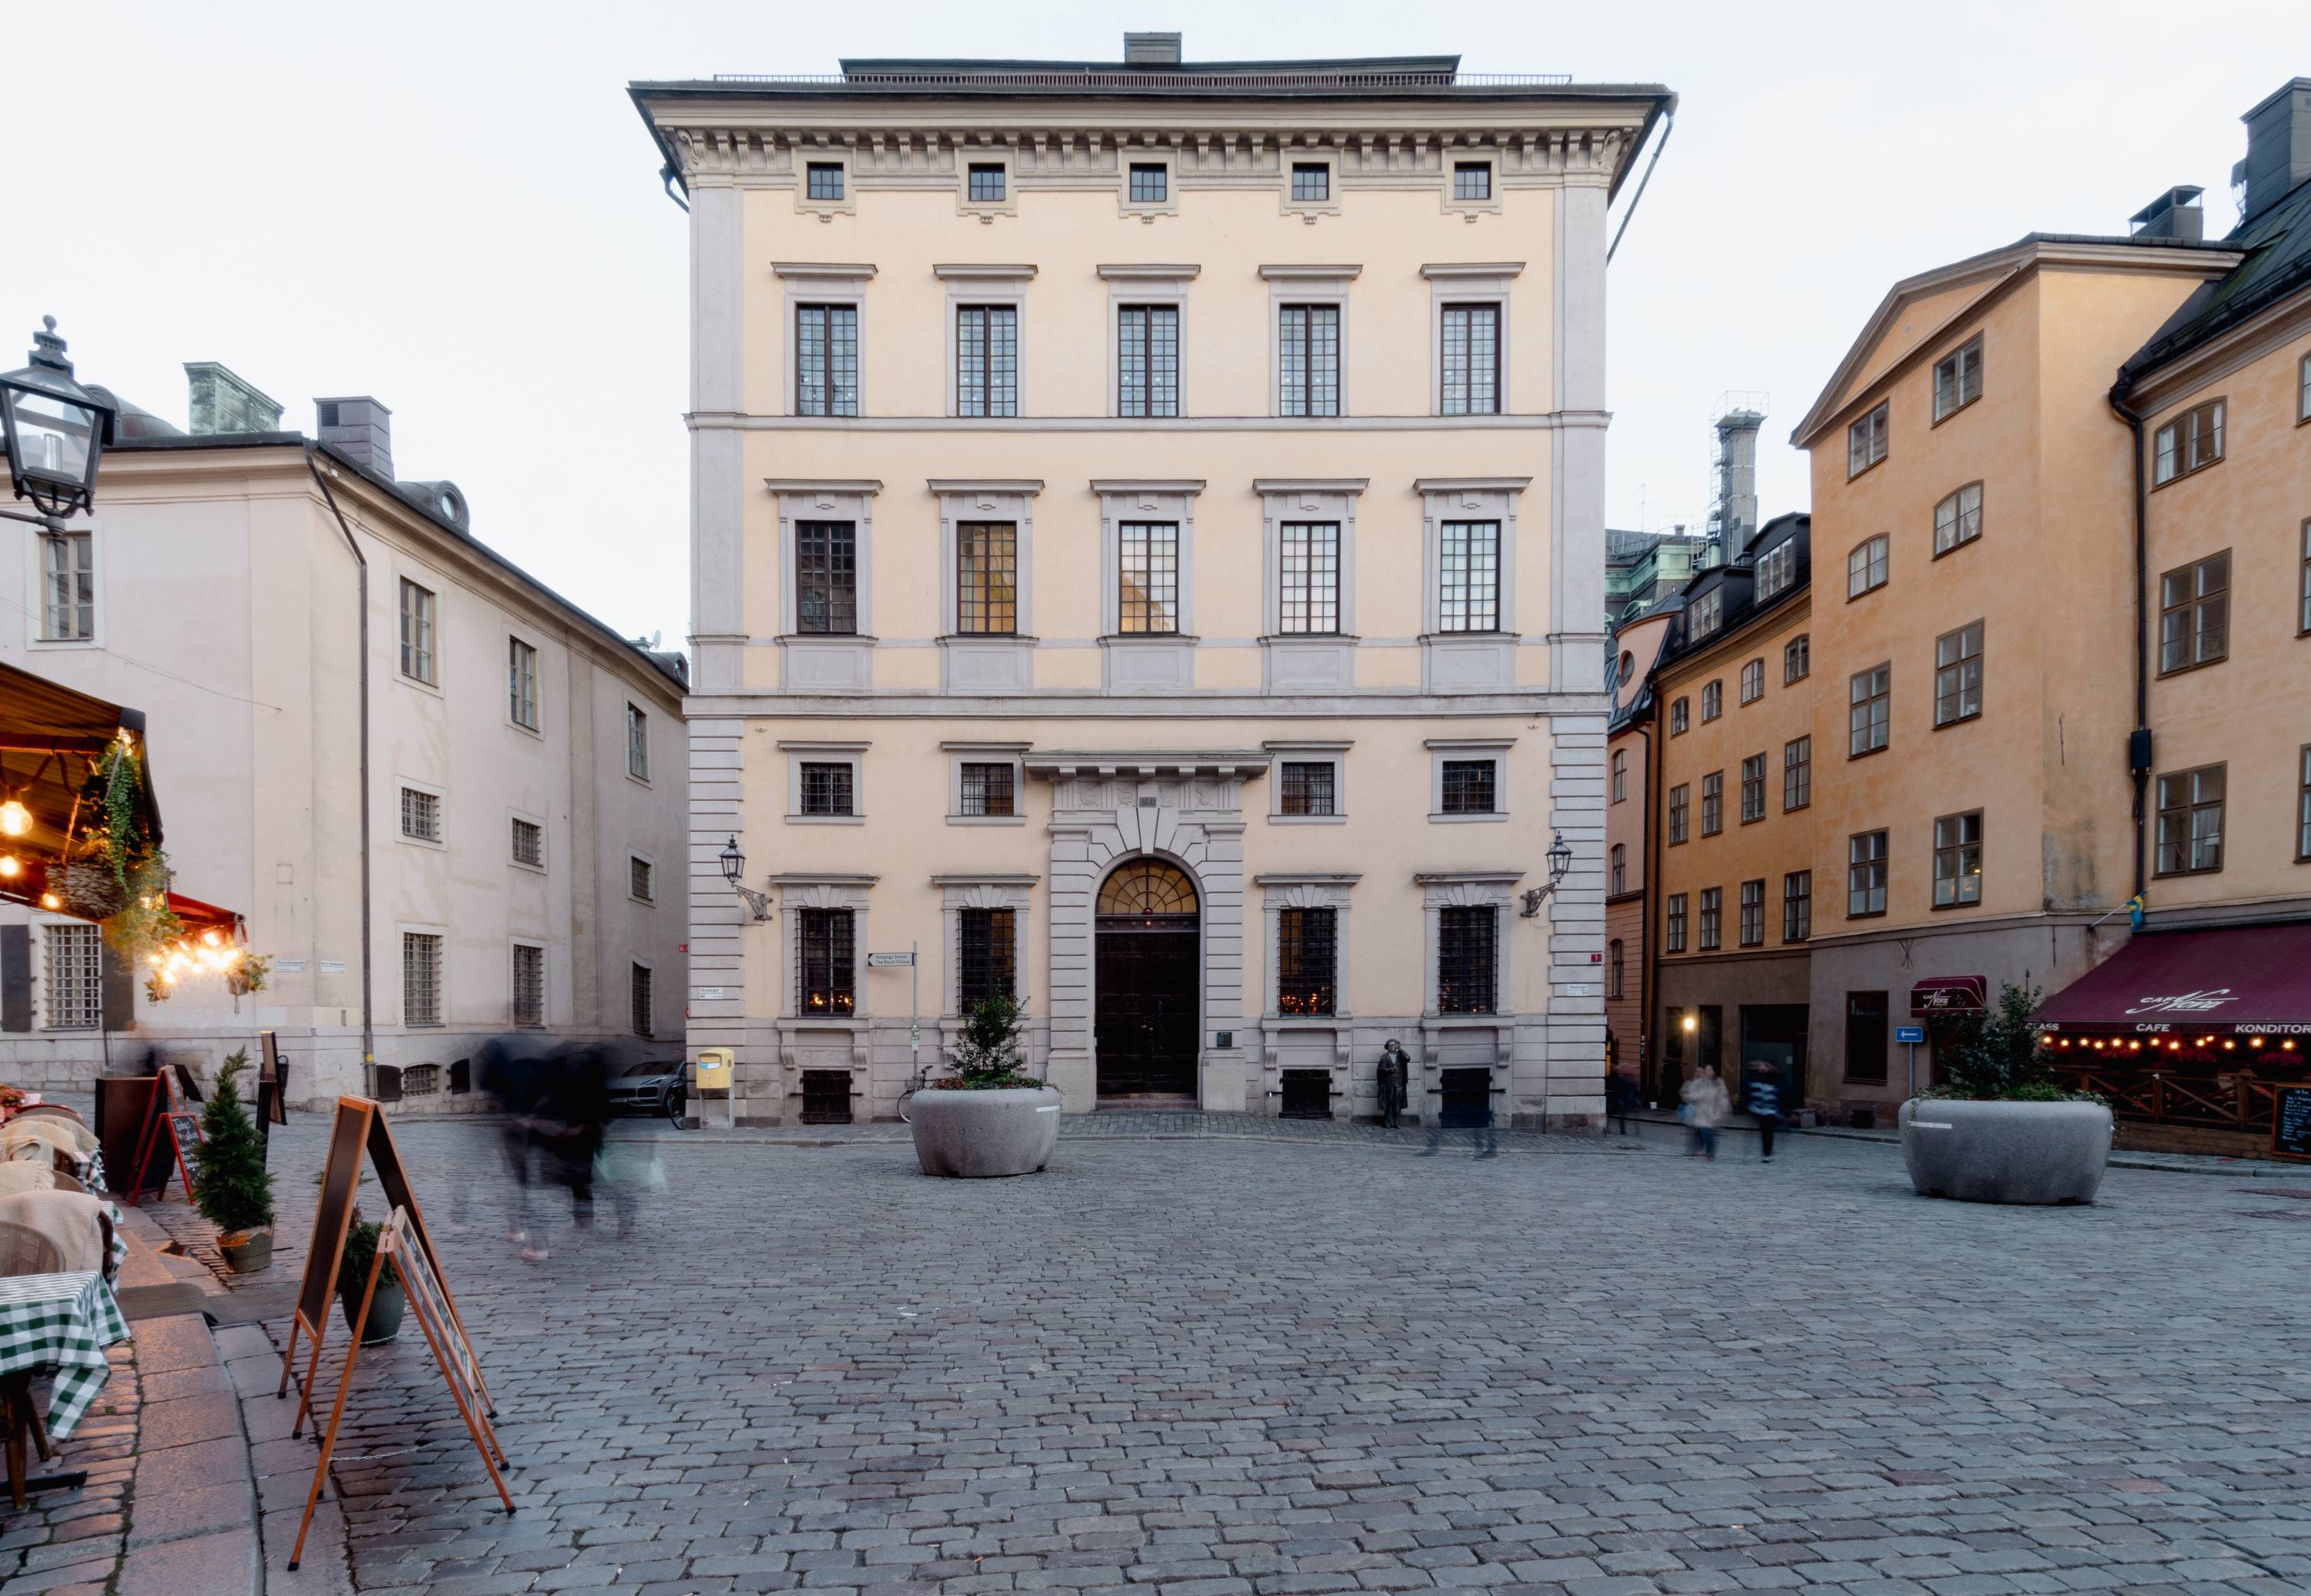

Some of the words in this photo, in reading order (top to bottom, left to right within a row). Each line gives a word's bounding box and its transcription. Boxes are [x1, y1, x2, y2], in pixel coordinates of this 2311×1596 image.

[1924, 989, 1951, 1008] Nova
[2125, 988, 2239, 1014] Nova
[2136, 1023, 2171, 1032] CAFE
[2236, 1024, 2311, 1033] KONDITOR
